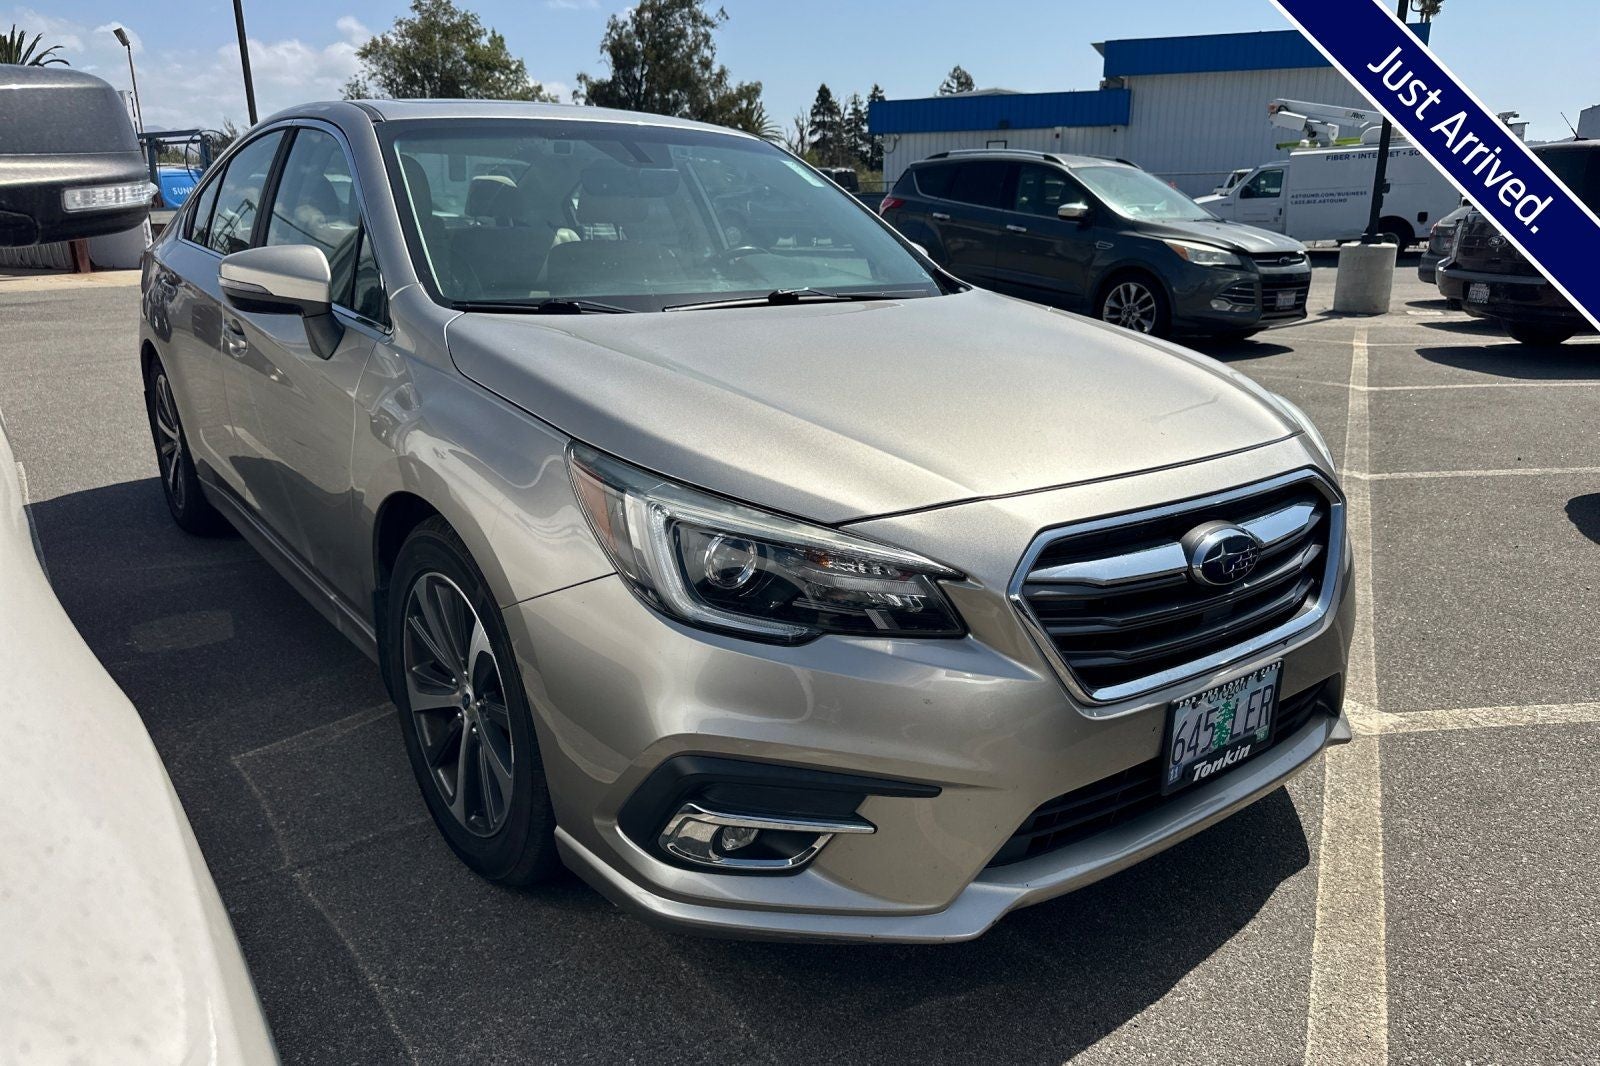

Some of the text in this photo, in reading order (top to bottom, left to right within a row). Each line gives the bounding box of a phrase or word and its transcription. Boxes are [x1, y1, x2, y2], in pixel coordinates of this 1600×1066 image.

[1326, 153, 1350, 161] FIBER
[1358, 150, 1400, 159] INTEET
[1172, 684, 1274, 765] 645 LER
[1193, 744, 1251, 782] Tonkin
